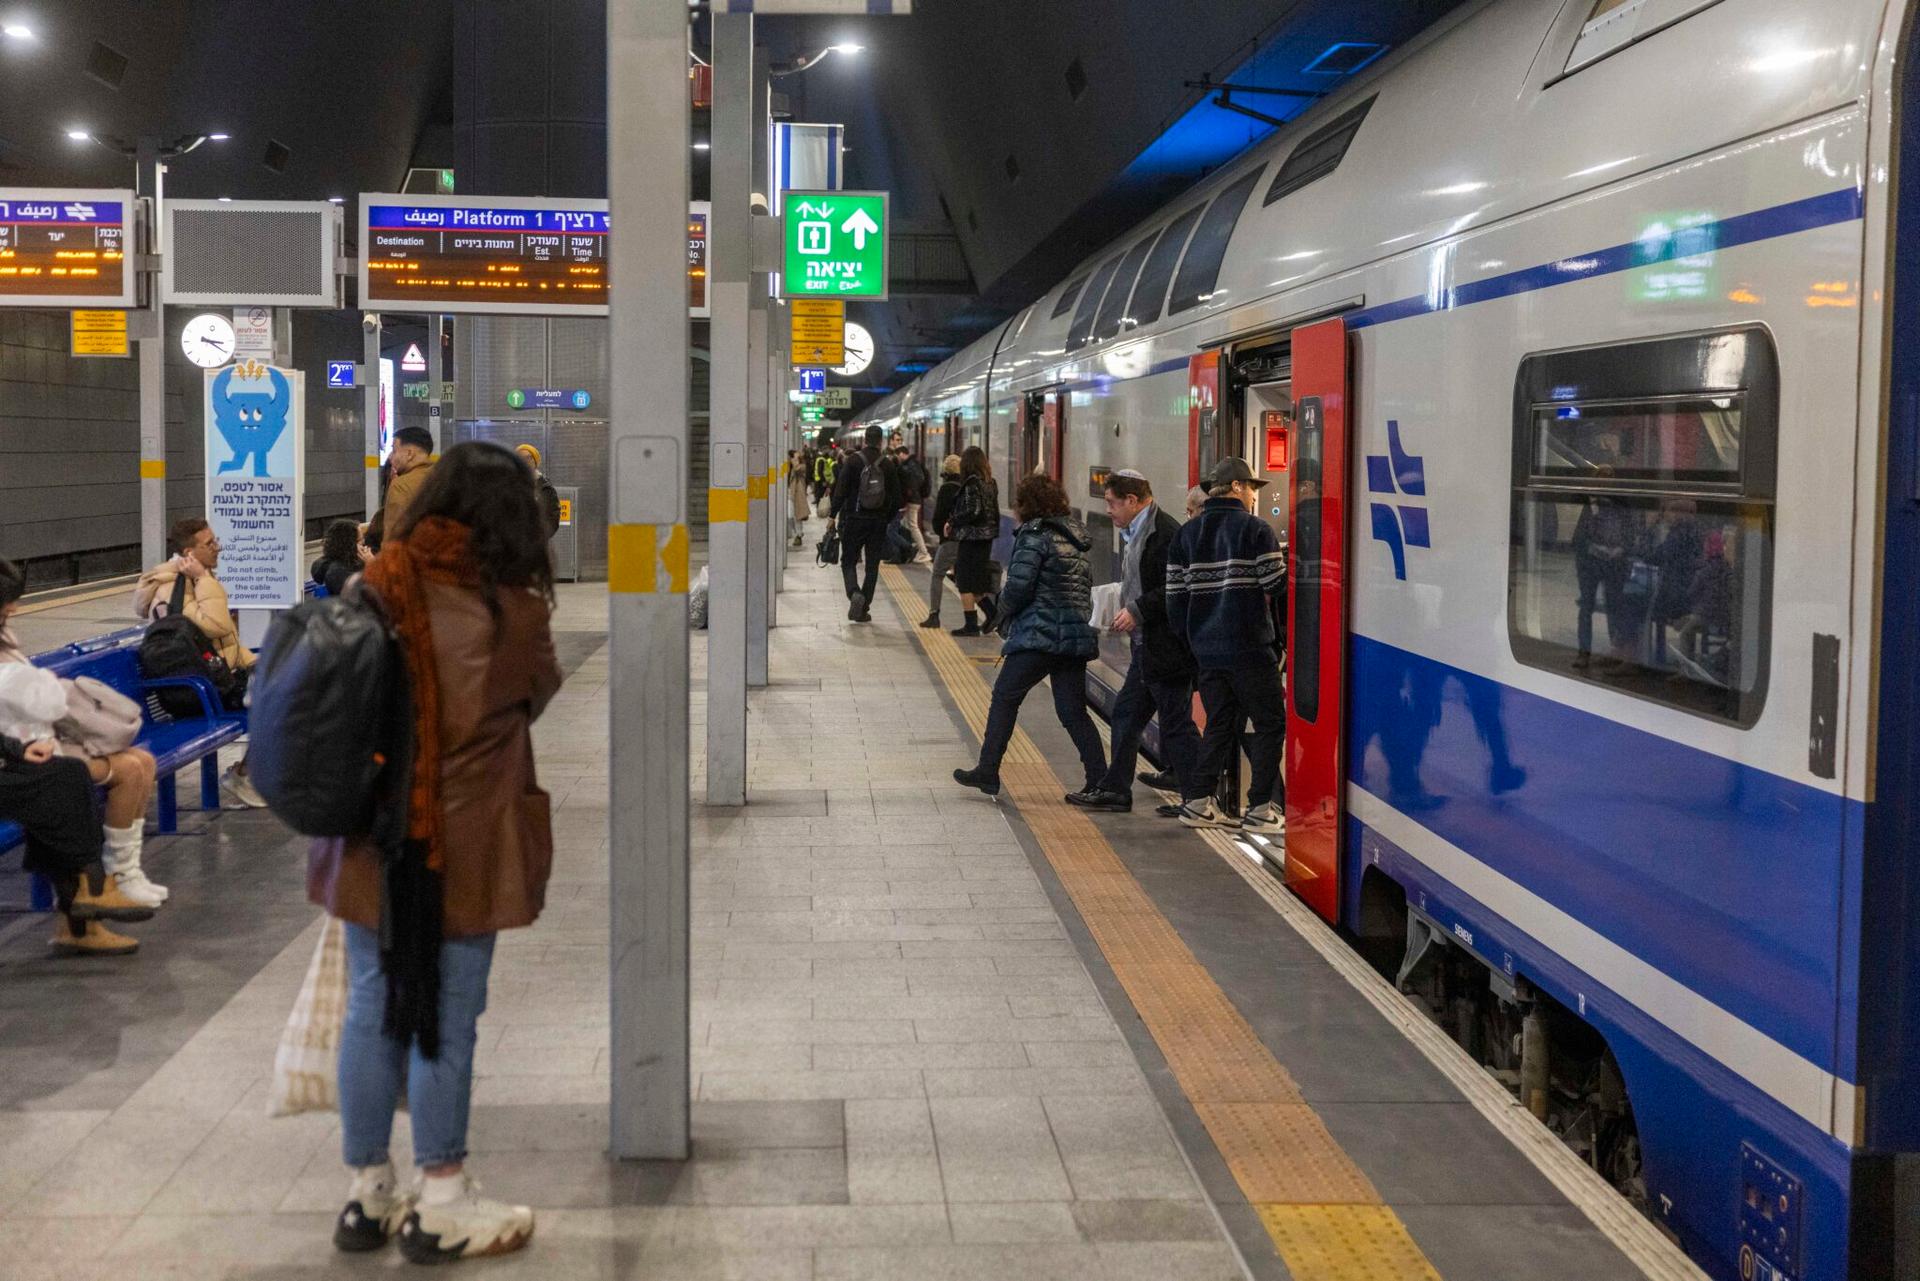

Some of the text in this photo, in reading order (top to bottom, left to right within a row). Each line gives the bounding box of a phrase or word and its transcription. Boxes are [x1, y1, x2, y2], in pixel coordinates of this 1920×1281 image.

[17, 203, 57, 219] رصيف
[405, 209, 594, 231] רציף 1 Platform رصيف
[48, 232, 65, 241] יעד
[376, 236, 424, 246] Destination
[527, 236, 559, 247] מעודכן
[571, 237, 593, 246] שעה
[485, 239, 514, 249] תחנות
[690, 240, 705, 249] רכב
[535, 247, 550, 256] Est.
[571, 247, 592, 257] Time
[806, 261, 862, 278] יציאה
[806, 280, 828, 290] EXIT
[330, 364, 342, 382] 2
[802, 370, 810, 389] 1
[431, 407, 439, 416] B
[258, 482, 284, 492] אסור
[213, 494, 292, 506] להתקרב ולגעת
[214, 506, 290, 517] בכבל או עמודי
[234, 593, 258, 601] power
[260, 592, 281, 600] poles
